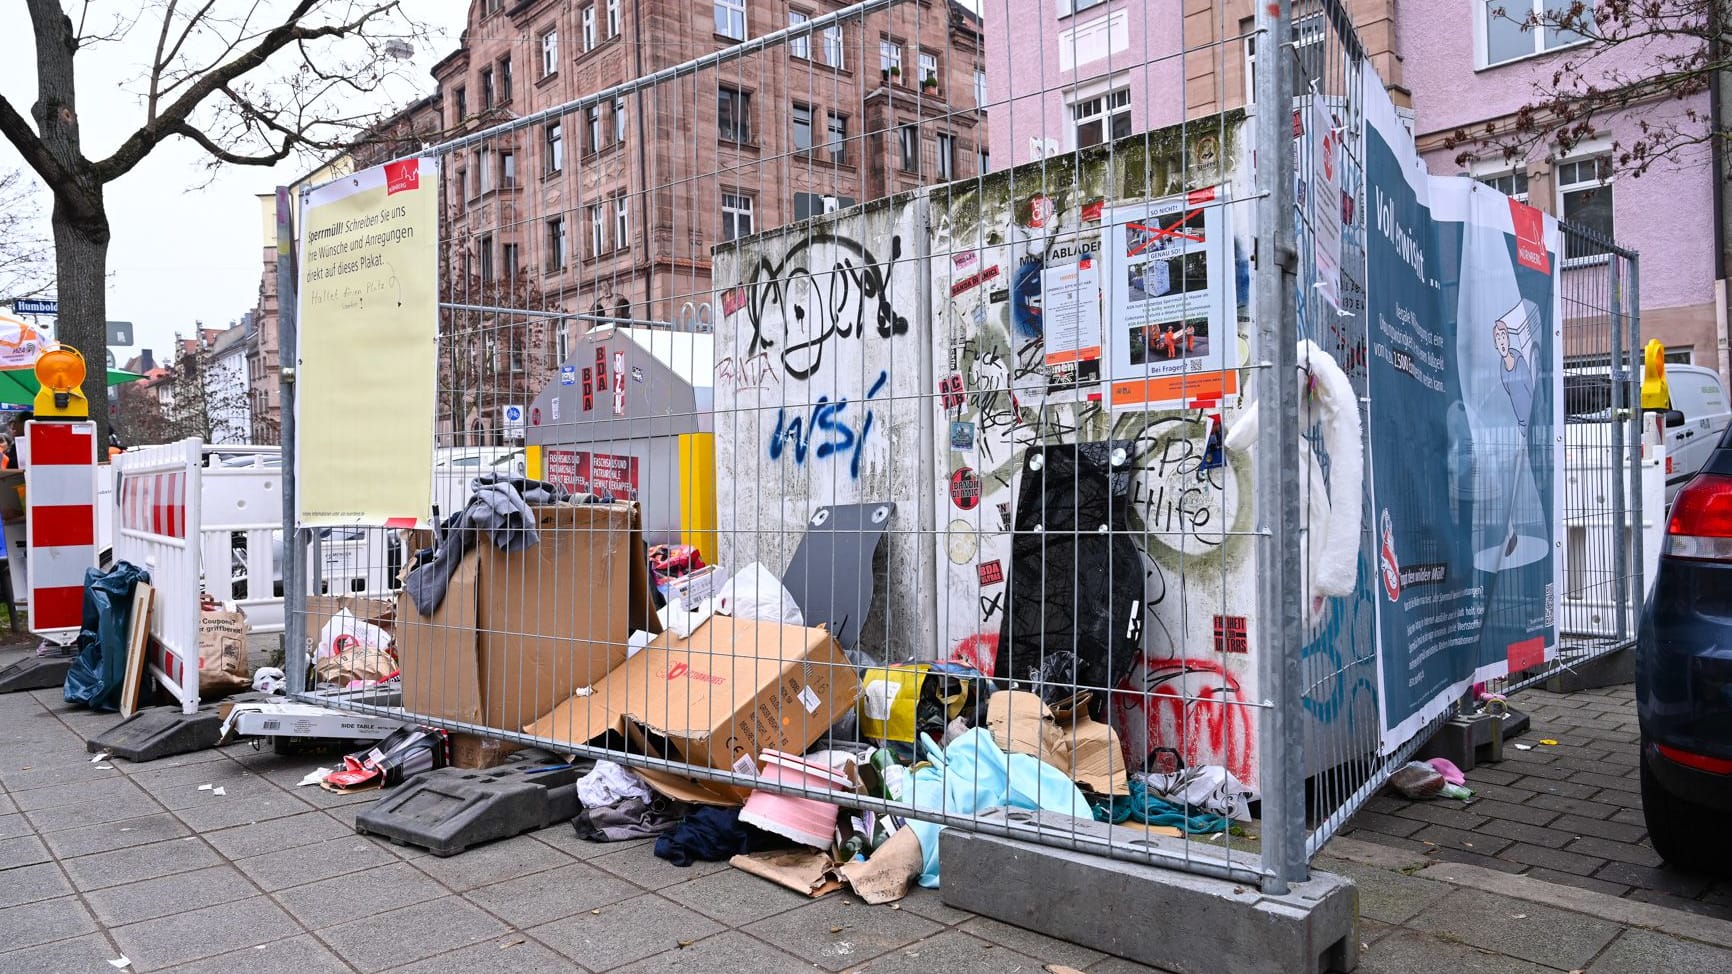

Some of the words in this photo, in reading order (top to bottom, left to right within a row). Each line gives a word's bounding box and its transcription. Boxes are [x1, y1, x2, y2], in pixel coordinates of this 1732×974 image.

[1160, 205, 1178, 215] NICHT!
[345, 214, 379, 233] Schreiben
[380, 208, 390, 224] Sie
[391, 205, 406, 219] uns
[318, 240, 348, 259] Wünsche
[349, 235, 364, 251] und
[364, 225, 414, 248] Anregungen
[1150, 250, 1168, 260] GENAU
[1170, 248, 1181, 256] SO!
[306, 267, 324, 283] direkt
[324, 262, 337, 278] auf
[337, 260, 359, 275] dieses
[360, 253, 385, 270] Plakat.
[981, 268, 999, 281] MICI
[963, 340, 1003, 370] Fuck
[980, 563, 1000, 577] BDA
[202, 617, 236, 626] Coupons?
